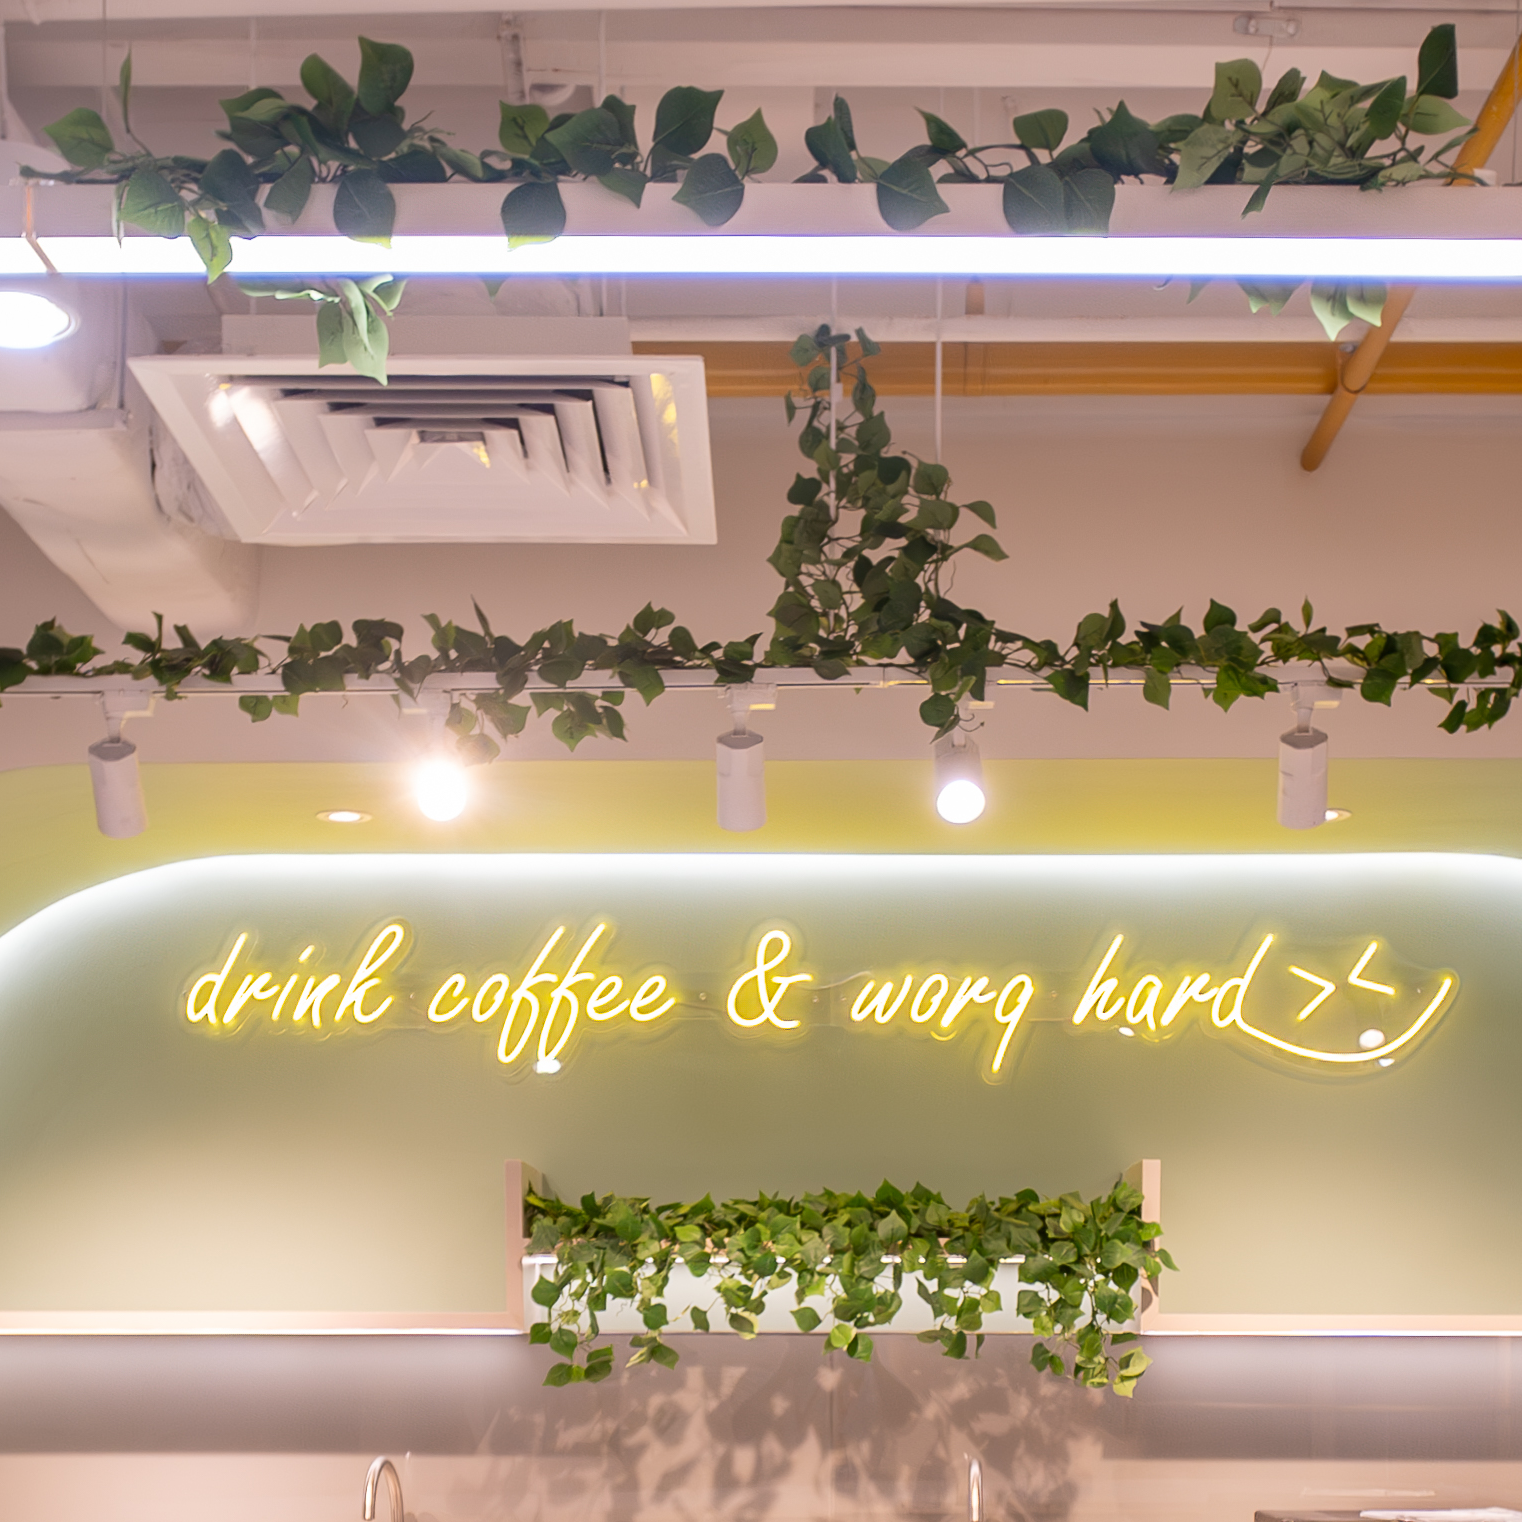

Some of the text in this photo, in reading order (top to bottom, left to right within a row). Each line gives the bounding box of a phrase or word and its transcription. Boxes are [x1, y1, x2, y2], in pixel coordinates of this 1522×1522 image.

[185, 923, 405, 1029] drink
[427, 921, 678, 1065] coffee
[726, 928, 814, 1030] &
[1072, 932, 1276, 1032] hard
